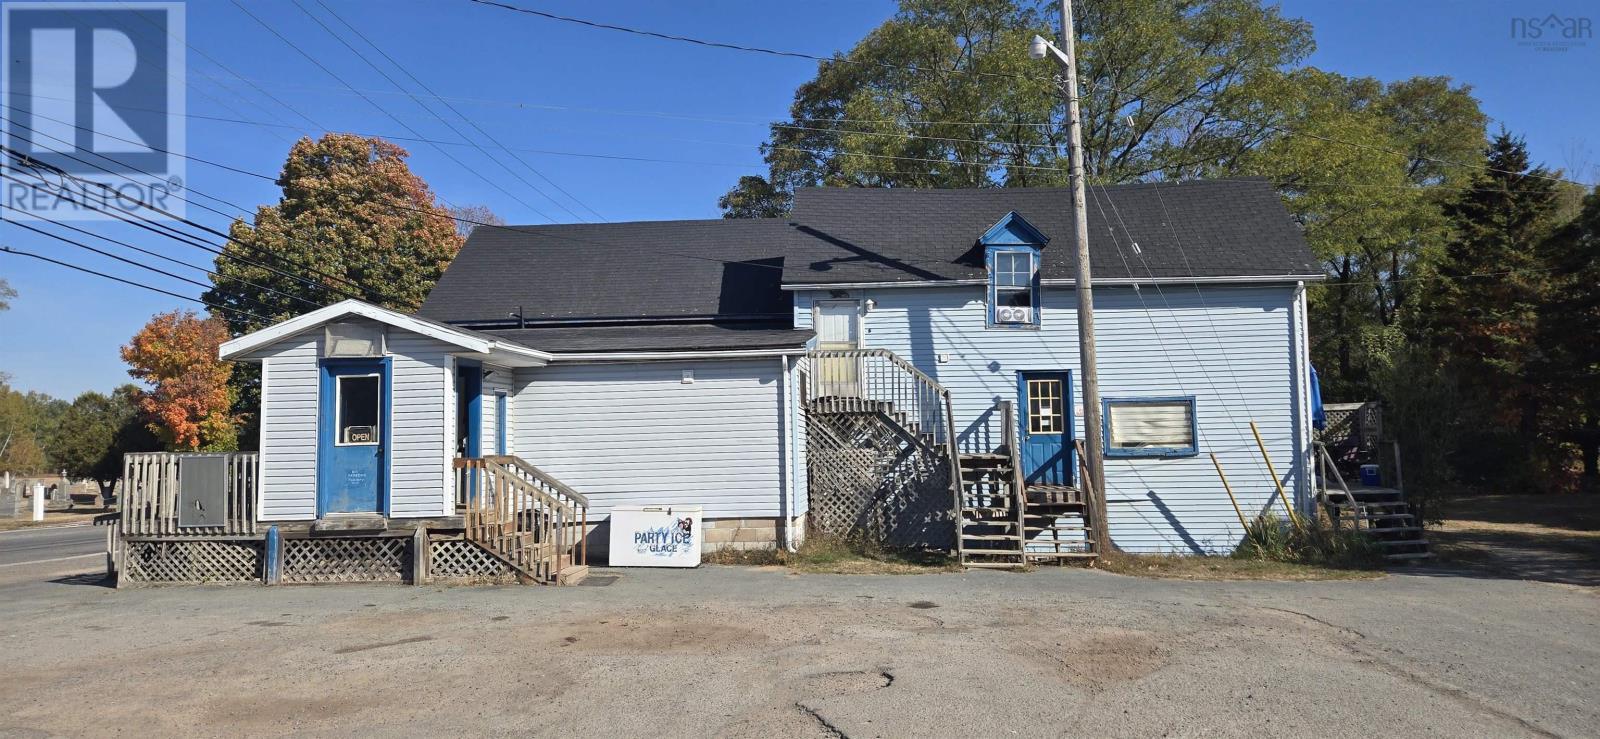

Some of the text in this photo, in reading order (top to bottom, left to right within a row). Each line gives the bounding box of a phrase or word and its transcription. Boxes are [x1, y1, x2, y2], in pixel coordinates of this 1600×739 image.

[351, 433, 370, 441] OPEN
[634, 531, 690, 544] PARTY ICE
[649, 544, 677, 552] GLACE
